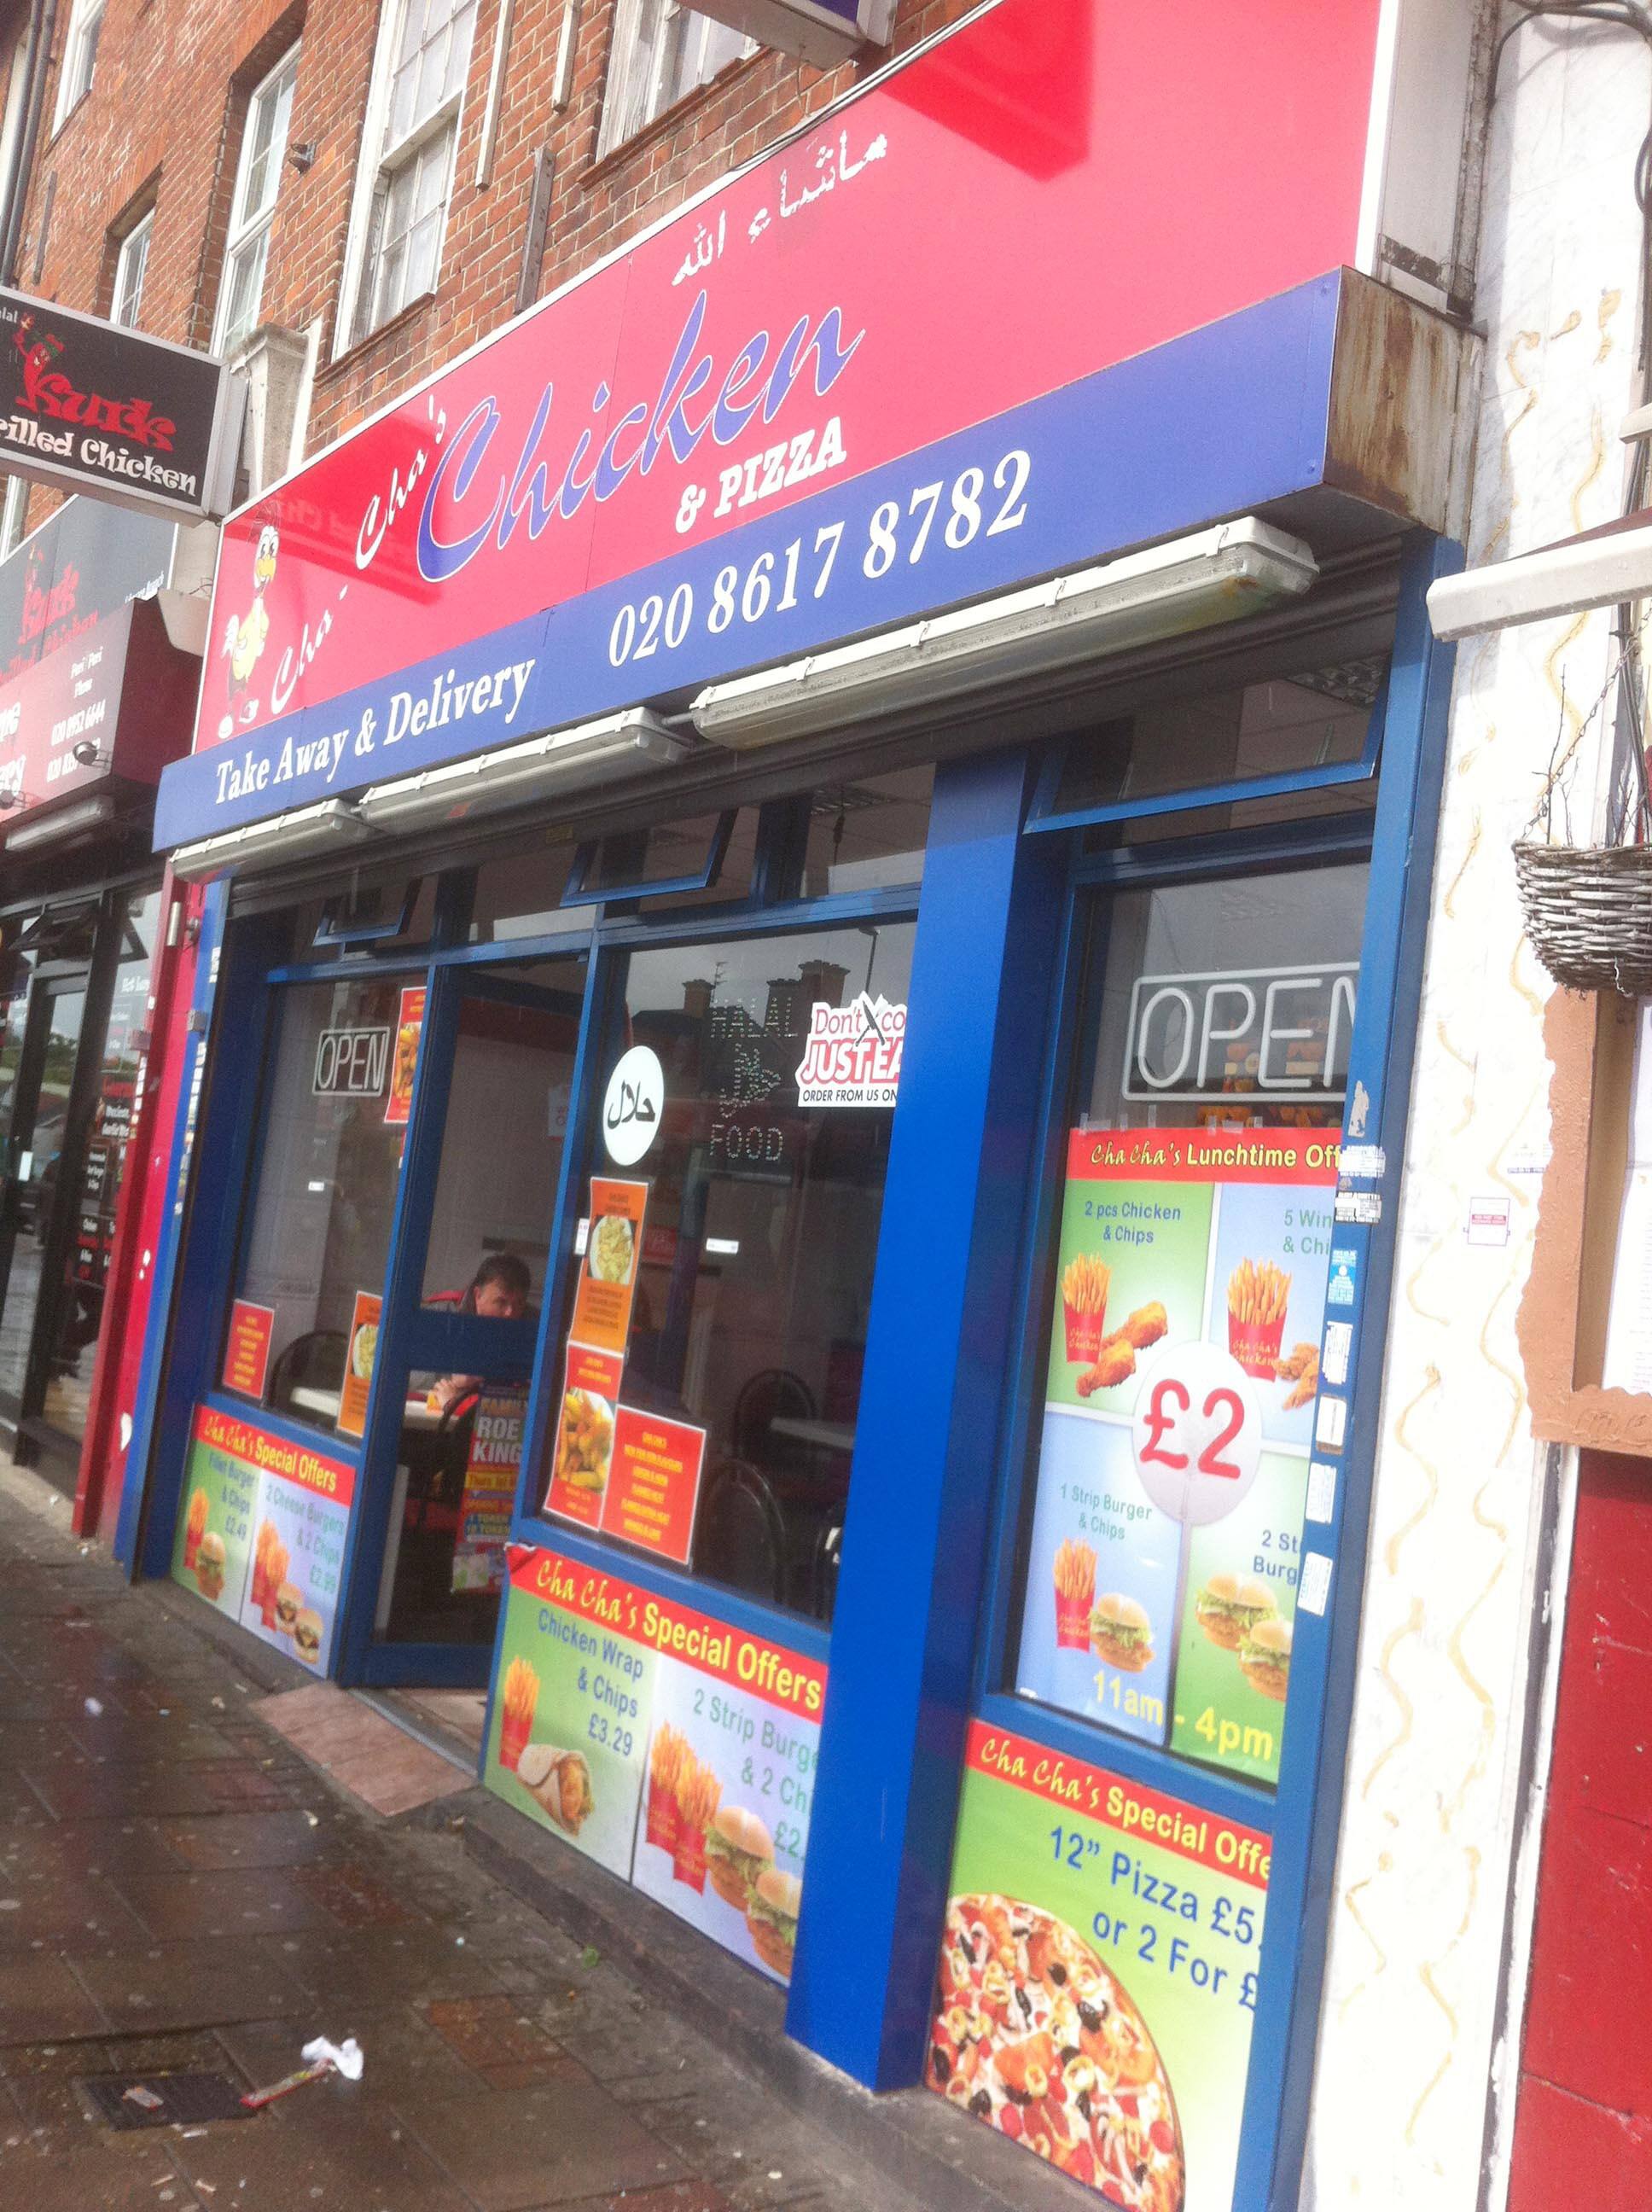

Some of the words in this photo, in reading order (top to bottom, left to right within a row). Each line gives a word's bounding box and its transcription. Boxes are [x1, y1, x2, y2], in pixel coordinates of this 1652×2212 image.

[416, 289, 866, 583] Chicken
[80, 438, 196, 497] Chicken
[675, 484, 707, 533] &
[713, 416, 847, 519] PIZZA
[270, 608, 334, 715] Cha
[355, 394, 448, 570] Cha's
[609, 582, 693, 667] 020
[707, 521, 846, 633] 8617
[863, 449, 1032, 579] 8782
[215, 759, 270, 805] Take
[273, 731, 348, 783] Away
[354, 707, 375, 758] &
[382, 658, 537, 746] Delivery
[814, 1005, 863, 1034] Don't
[317, 1033, 386, 1091] OPEN
[800, 1037, 871, 1085] JUST
[607, 1079, 656, 1130] حلال
[802, 1089, 833, 1103] ORDER
[835, 1088, 864, 1103] FROM
[866, 1088, 879, 1103] US
[709, 1122, 784, 1161] FOOD
[1091, 1141, 1126, 1167] Cha
[1129, 1140, 1182, 1167] Cha's
[1186, 1143, 1297, 1167] Lunchtime
[1085, 1200, 1093, 1217] 2
[1096, 1203, 1118, 1221] pcs
[1121, 1202, 1182, 1221] Chicken
[1102, 1225, 1112, 1241] &
[1114, 1225, 1155, 1246] Chips
[1283, 1208, 1294, 1227] 5
[1299, 1208, 1332, 1229] Win
[1283, 1237, 1295, 1254] &
[1139, 1377, 1245, 1481] £2
[255, 1435, 298, 1476] Special
[299, 1453, 337, 1493] Offers
[1060, 1481, 1068, 1499] 1
[1071, 1484, 1101, 1511] Strip
[1102, 1492, 1153, 1522] Burger
[1079, 1511, 1088, 1530] &
[1091, 1512, 1126, 1542] Chips
[1261, 1528, 1272, 1548] 2
[536, 1558, 576, 1602] Cha
[579, 1578, 638, 1631] Cha's
[642, 1601, 732, 1671] Special
[736, 1641, 823, 1711] Offers
[537, 1607, 599, 1657] Chicken
[602, 1638, 644, 1684] Wrap
[578, 1666, 589, 1694] &
[592, 1674, 639, 1719] Chips
[692, 1687, 705, 1716] 2
[709, 1695, 755, 1744] Strip
[1092, 1668, 1165, 1727] 11am
[1195, 1706, 1274, 1762] 4pm
[587, 1712, 634, 1758] £3.29
[741, 1755, 754, 1787] &
[759, 1766, 774, 1796] 2
[980, 1737, 1027, 1779] Cha
[1032, 1758, 1101, 1810] Cha's
[1106, 1784, 1208, 1854] Special
[1109, 1850, 1199, 1923] Pizza
[1092, 1911, 1129, 1947] or
[1137, 1923, 1158, 1964] 2
[1168, 1936, 1229, 1995] For
